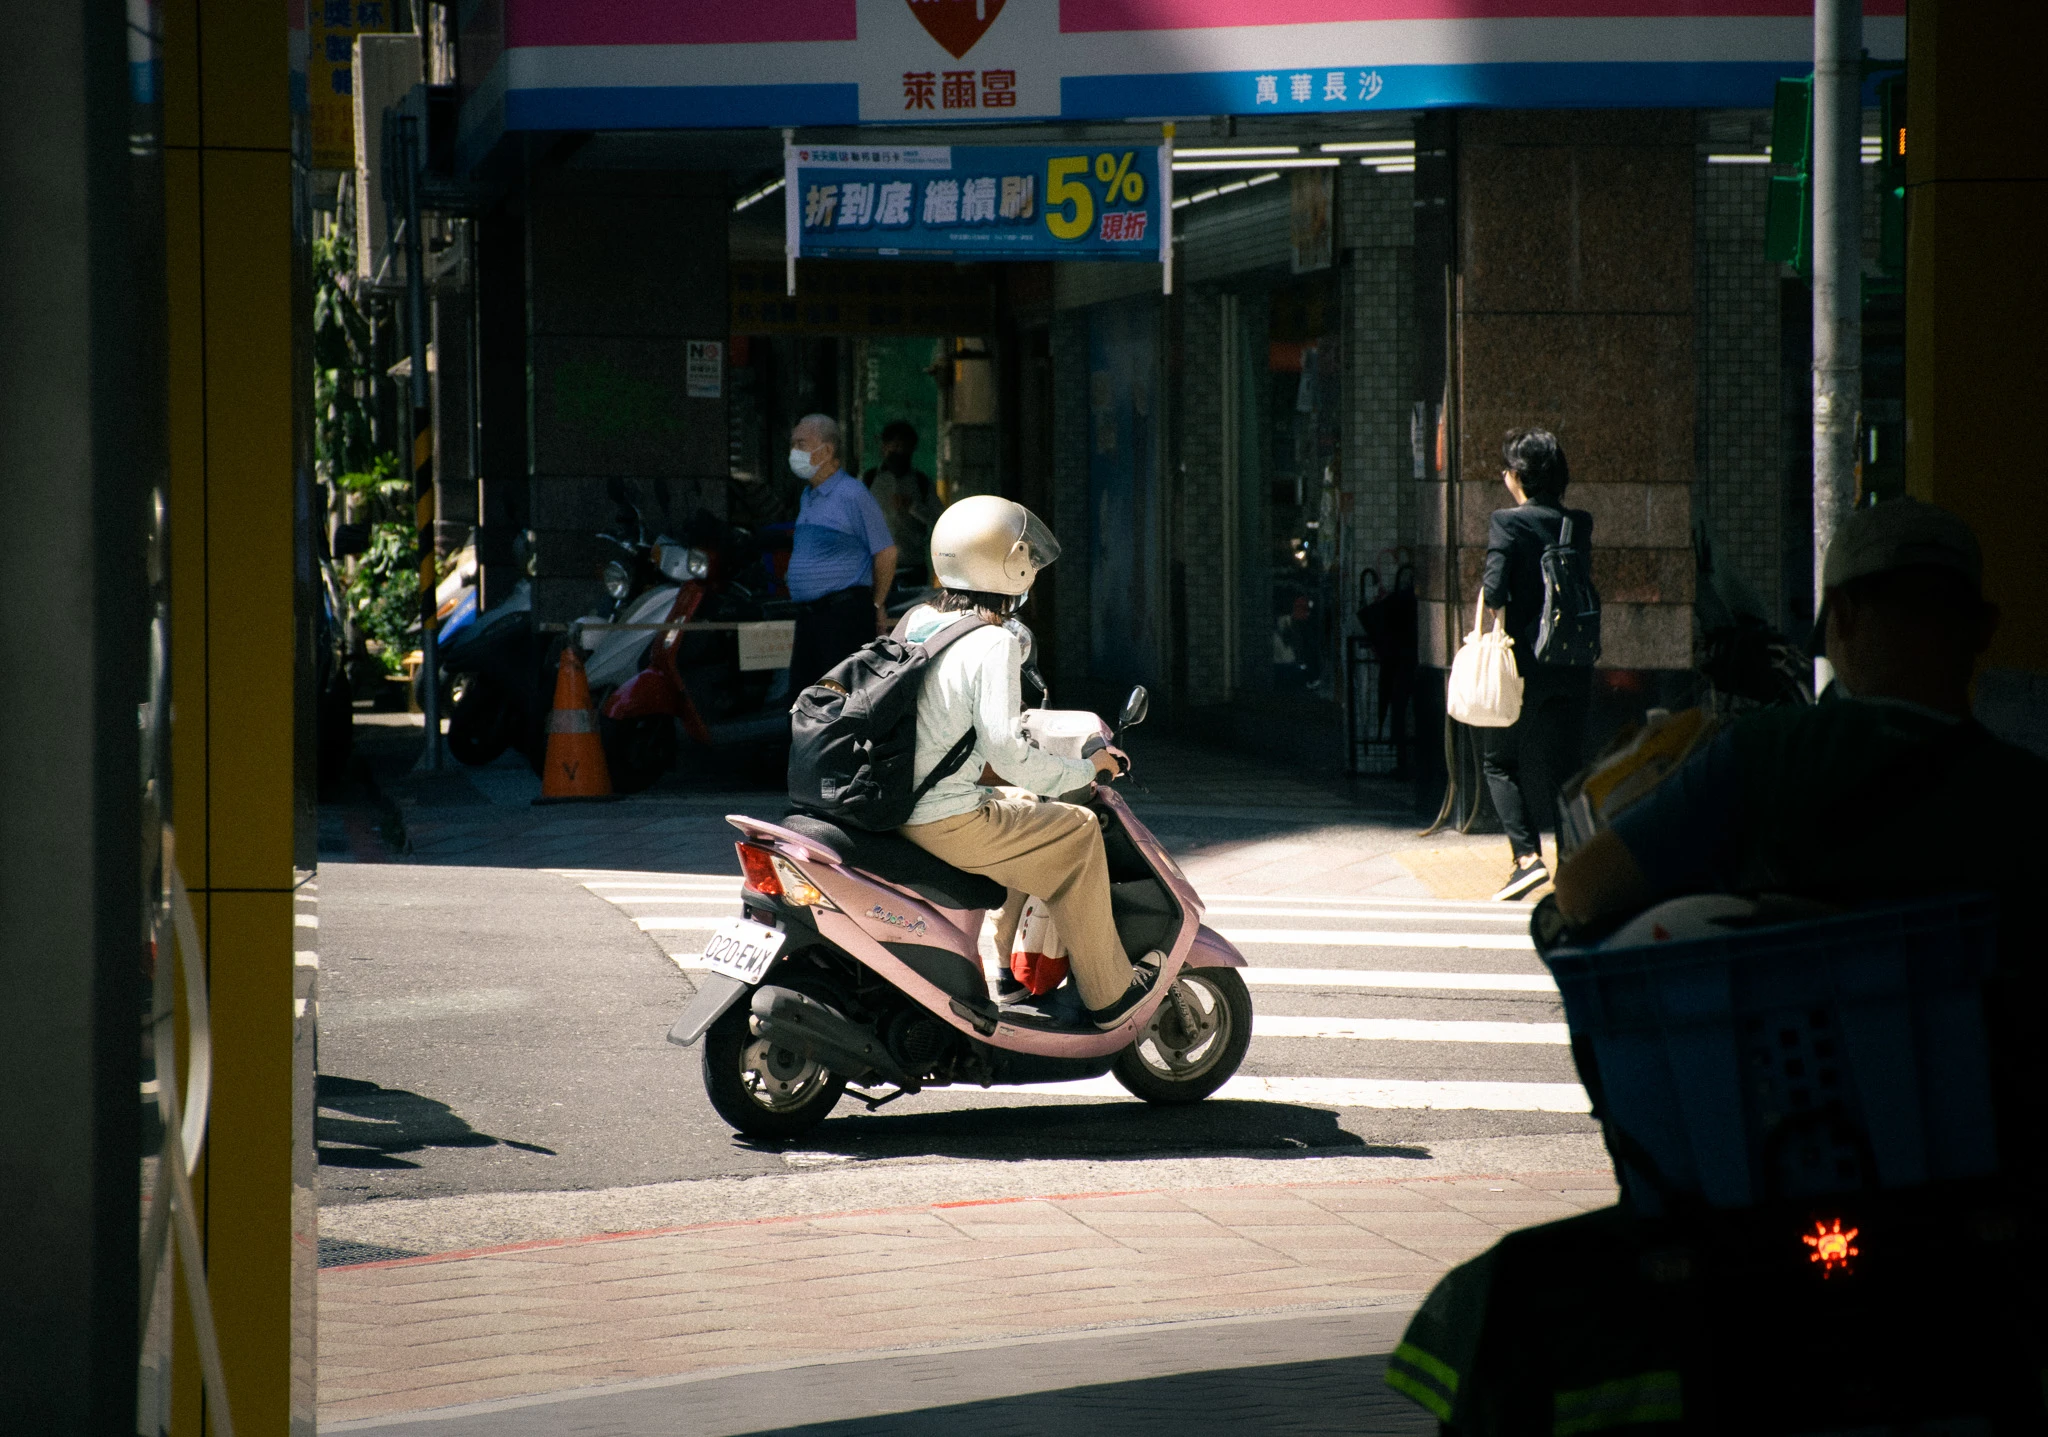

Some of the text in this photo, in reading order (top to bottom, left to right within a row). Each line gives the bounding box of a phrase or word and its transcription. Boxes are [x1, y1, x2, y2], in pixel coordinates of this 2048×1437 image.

[903, 70, 1016, 110] 萊爾富
[1255, 71, 1383, 104] 萬華長沙
[805, 175, 1034, 228] 折到底 繼續刷
[1045, 152, 1144, 240] 5%
[1101, 210, 1147, 241] 現折
